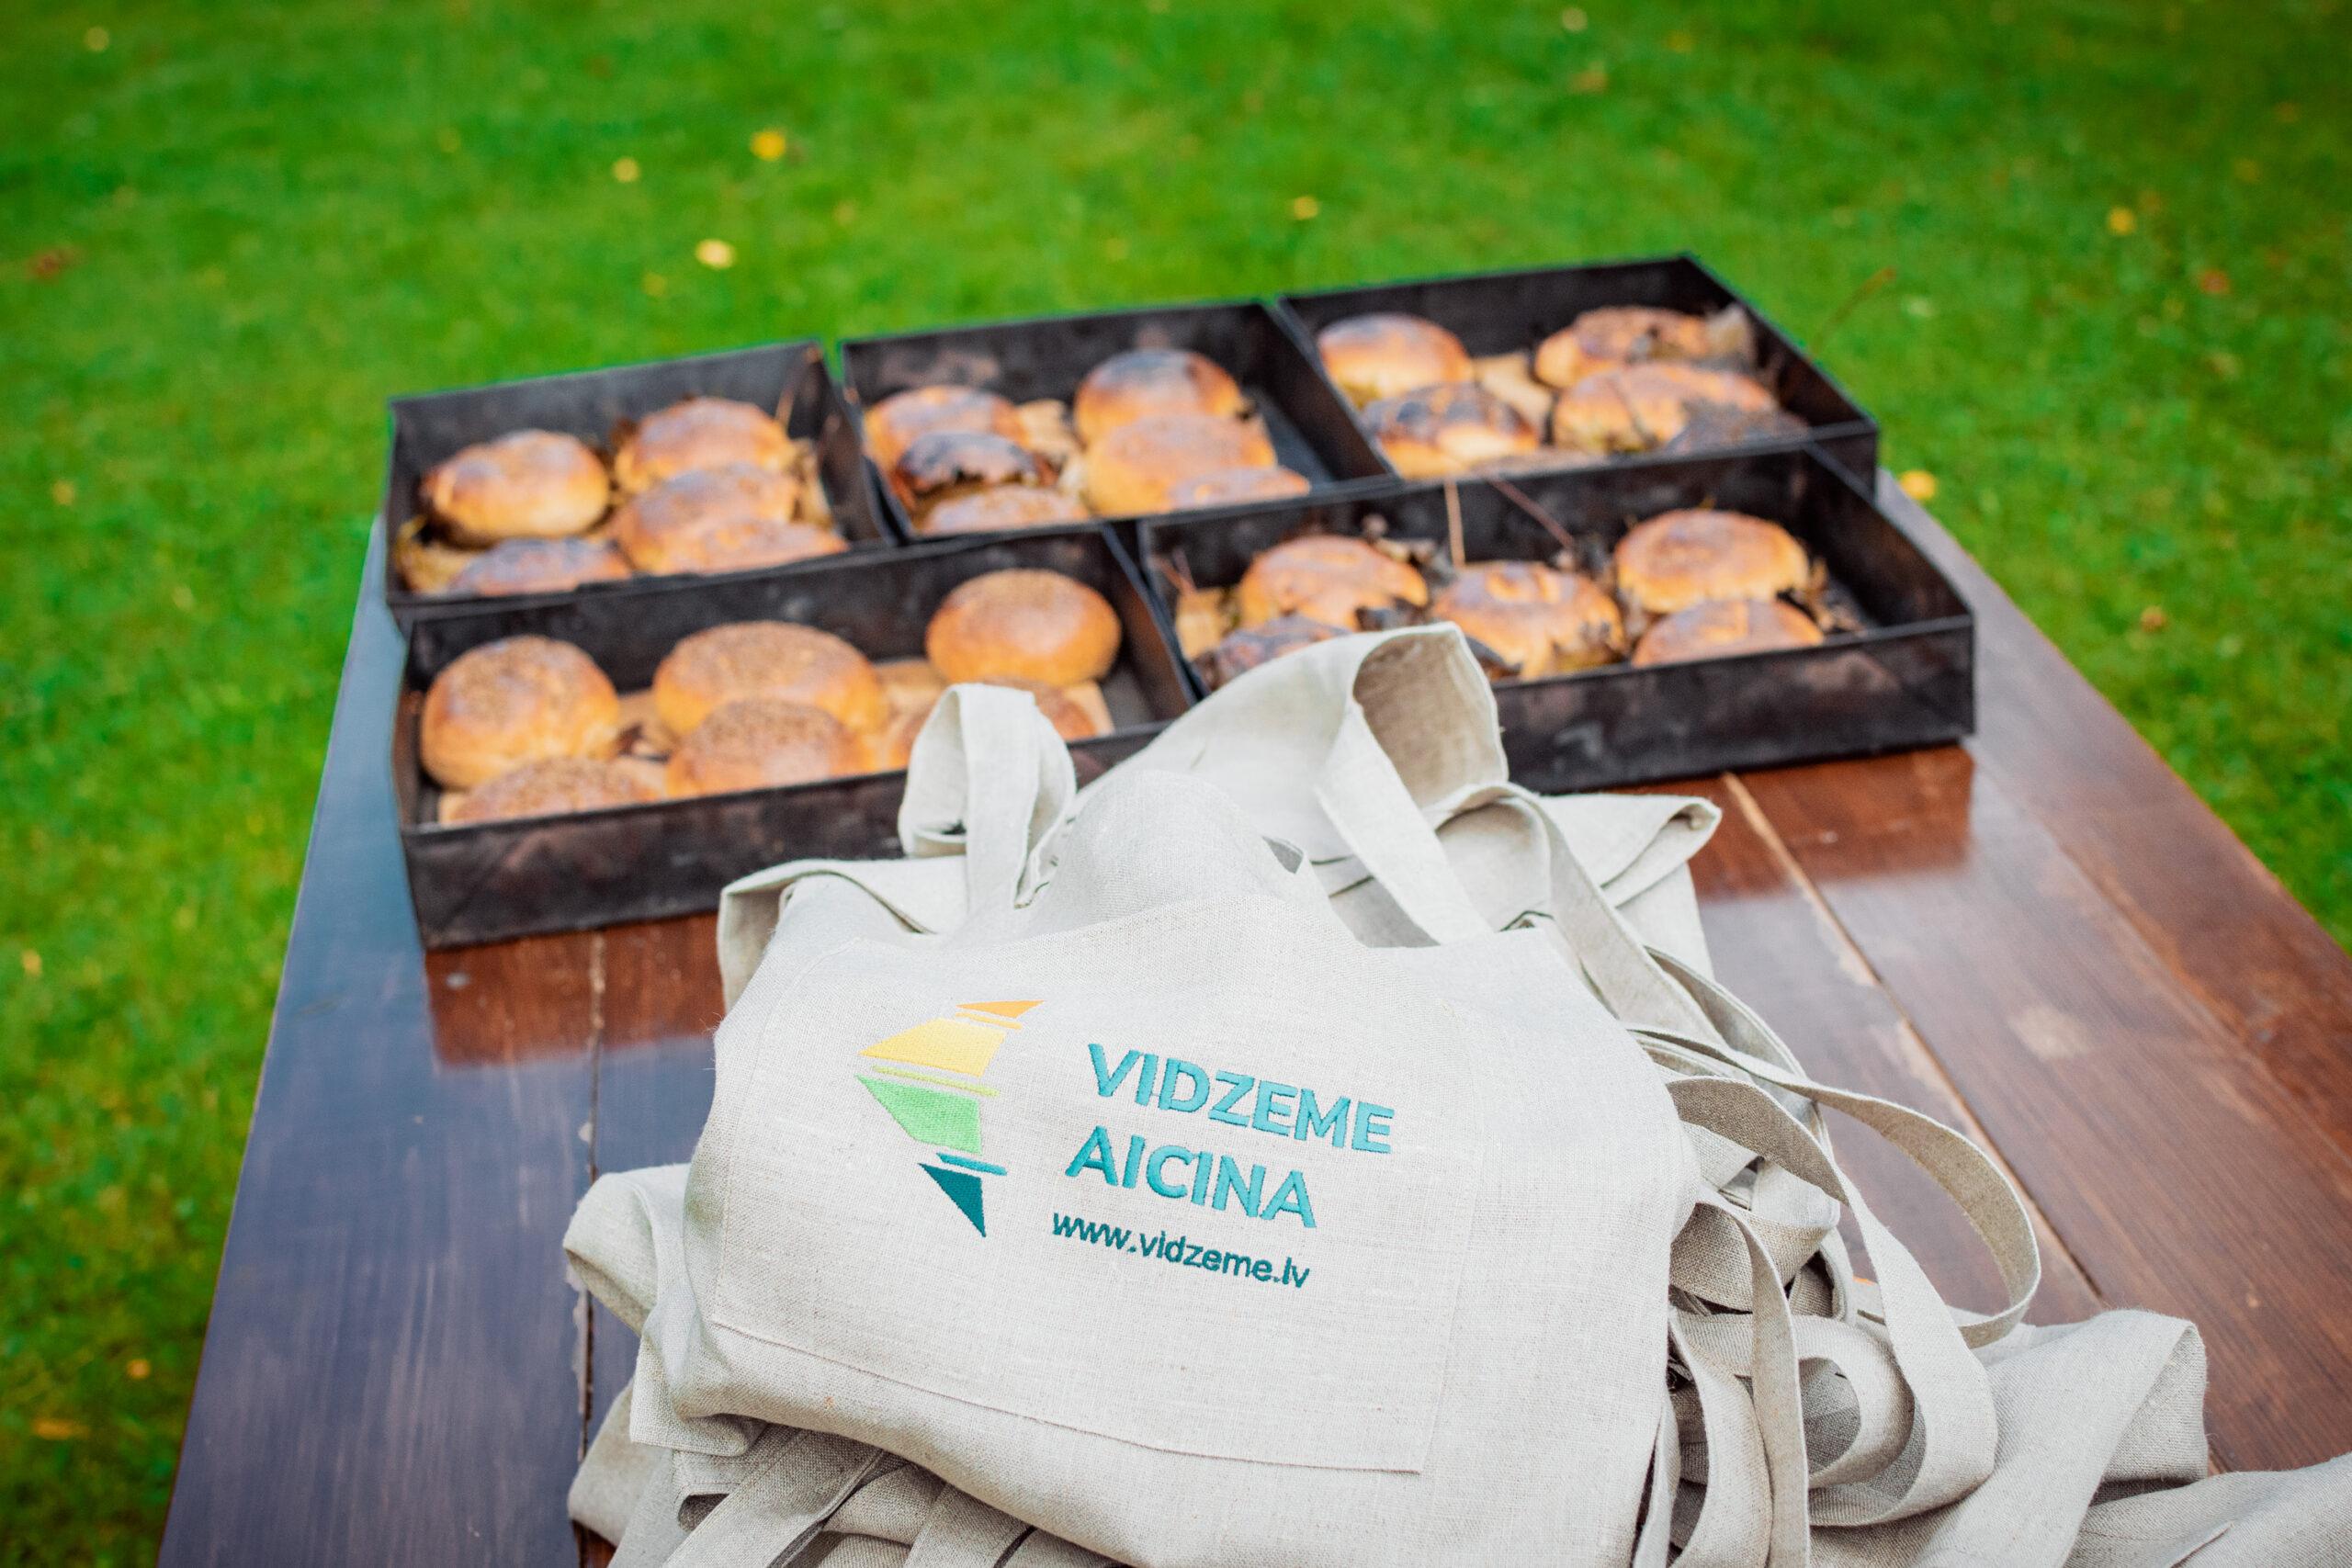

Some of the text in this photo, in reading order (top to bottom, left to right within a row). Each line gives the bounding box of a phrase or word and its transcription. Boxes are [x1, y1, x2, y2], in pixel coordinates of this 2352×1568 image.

[1087, 1043, 1396, 1155] VIDZEME
[1064, 1125, 1317, 1228] AICINA
[1052, 1213, 1311, 1290] www.vidzeme.lv
